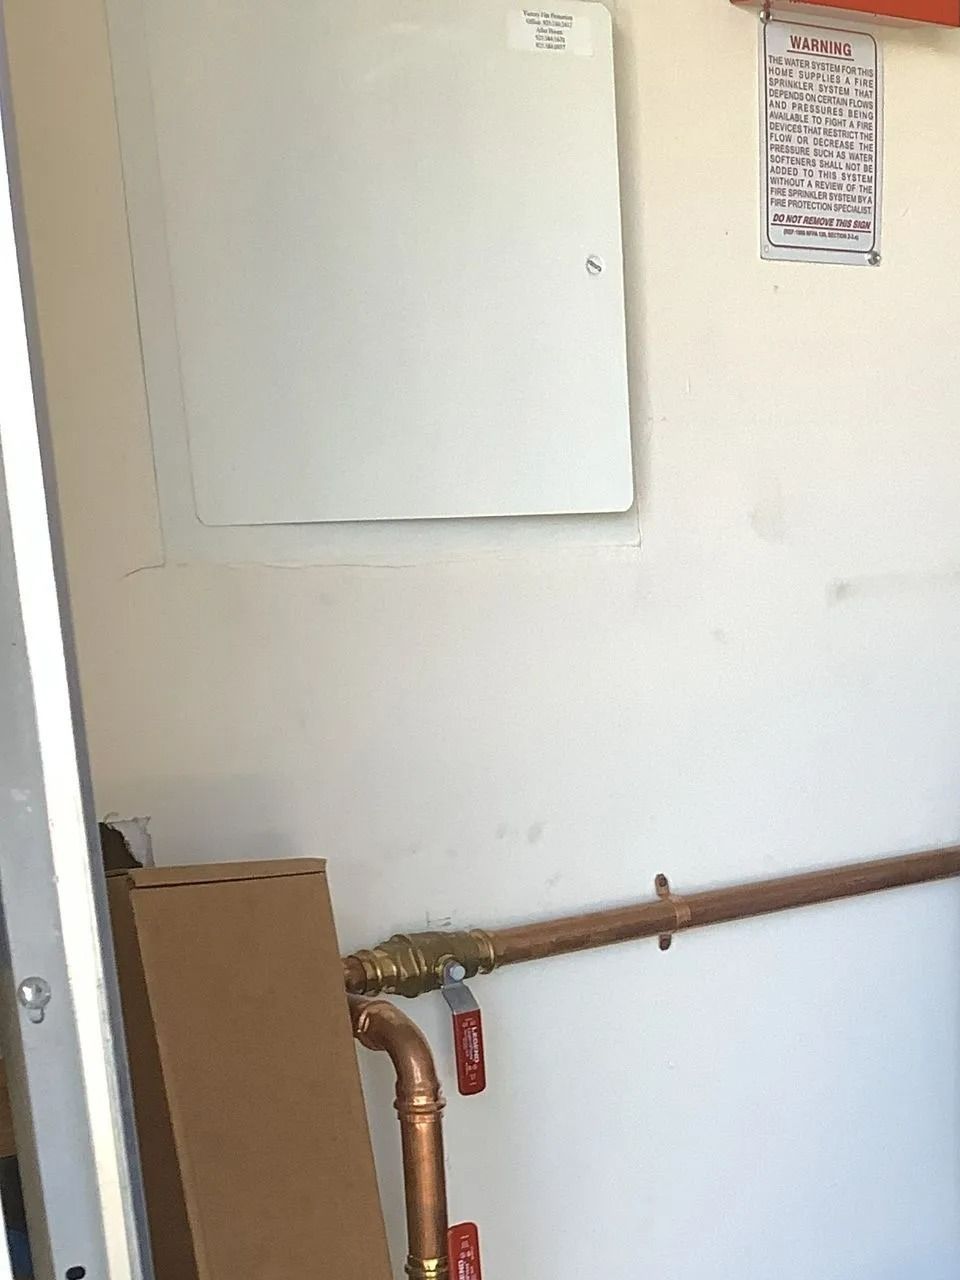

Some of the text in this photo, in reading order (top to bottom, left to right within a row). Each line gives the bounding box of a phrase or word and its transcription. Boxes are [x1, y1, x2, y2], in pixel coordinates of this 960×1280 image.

[790, 35, 852, 56] WARNING
[768, 55, 873, 76] THE WATER SYSTEM FOR THIS
[768, 67, 873, 88] HOME SUPPLIES A FIRE
[769, 78, 872, 98] SPRINKLER SYSTEM THAT
[769, 89, 873, 109] DEPENDS ON CERTAIN FLOWS
[769, 100, 873, 119] AND PRESSURES BEING
[770, 111, 872, 130] AVAILABLE TO FIGHT A FIRE
[770, 122, 873, 141] DEVICES THAT RESTRICT THE
[770, 133, 873, 152] FLOW OR DECREASE THE
[770, 144, 873, 162] PRESSURE SUCH AS WATER
[770, 155, 872, 173] SOFTENERS SHALL NOT BE
[770, 166, 872, 183] ADDED TO THIS SYSTEM
[770, 177, 872, 194] WITHOUT A REVIEW OF THE
[770, 188, 872, 204] FIRE SPRINKLER SYSTEM BY A
[770, 198, 786, 207] FIRE
[788, 199, 832, 211] PROTECTION
[773, 214, 871, 229] DO NOT REMOVE THIS SIGN
[471, 1026, 480, 1062] LEGEND
